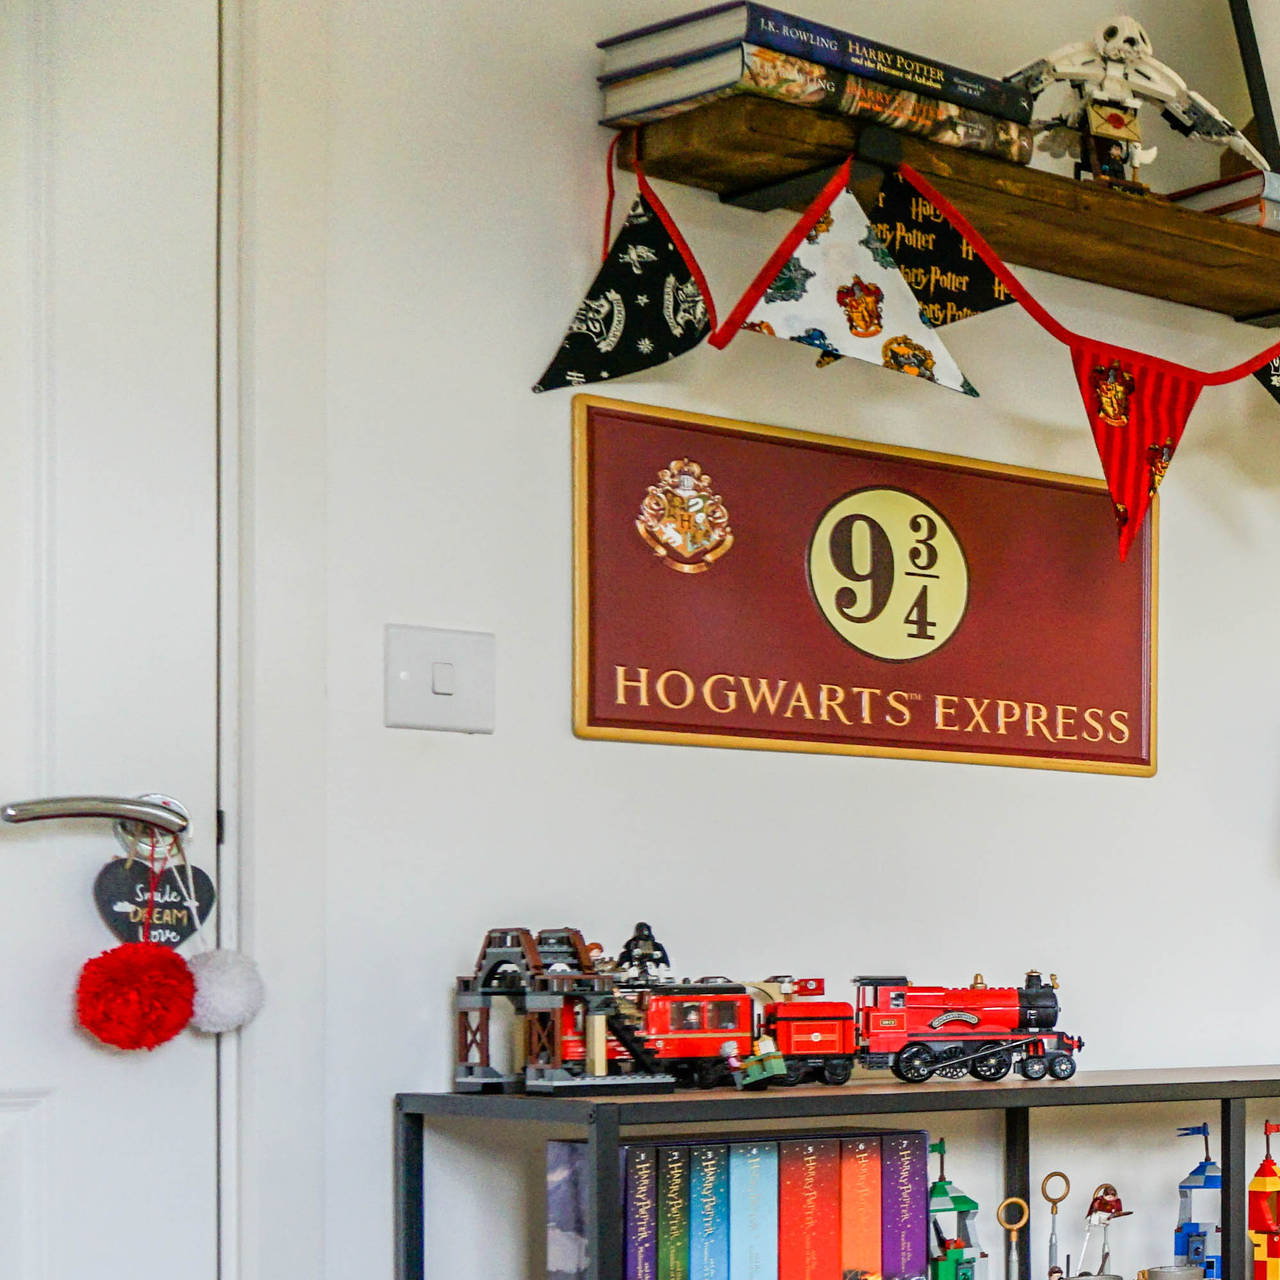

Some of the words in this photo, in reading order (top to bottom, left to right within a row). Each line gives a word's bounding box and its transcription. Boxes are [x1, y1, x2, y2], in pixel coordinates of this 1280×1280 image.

[782, 25, 838, 51] ROWLING
[848, 40, 892, 65] HARRY
[896, 55, 945, 82] POTTER
[896, 222, 935, 255] Potter
[930, 266, 969, 297] Potter
[935, 694, 1131, 744] EXPRESS
[635, 1163, 650, 1200] HARRY
[668, 1163, 683, 1200] HARRY
[701, 1160, 717, 1196] HARRY
[804, 1156, 817, 1191] HARRY
[899, 1150, 912, 1184] HARRY
[634, 1200, 651, 1241] POTTER
[666, 1199, 683, 1240] POTTER
[701, 1197, 716, 1236] POTTER
[897, 1184, 912, 1223] POTTER
